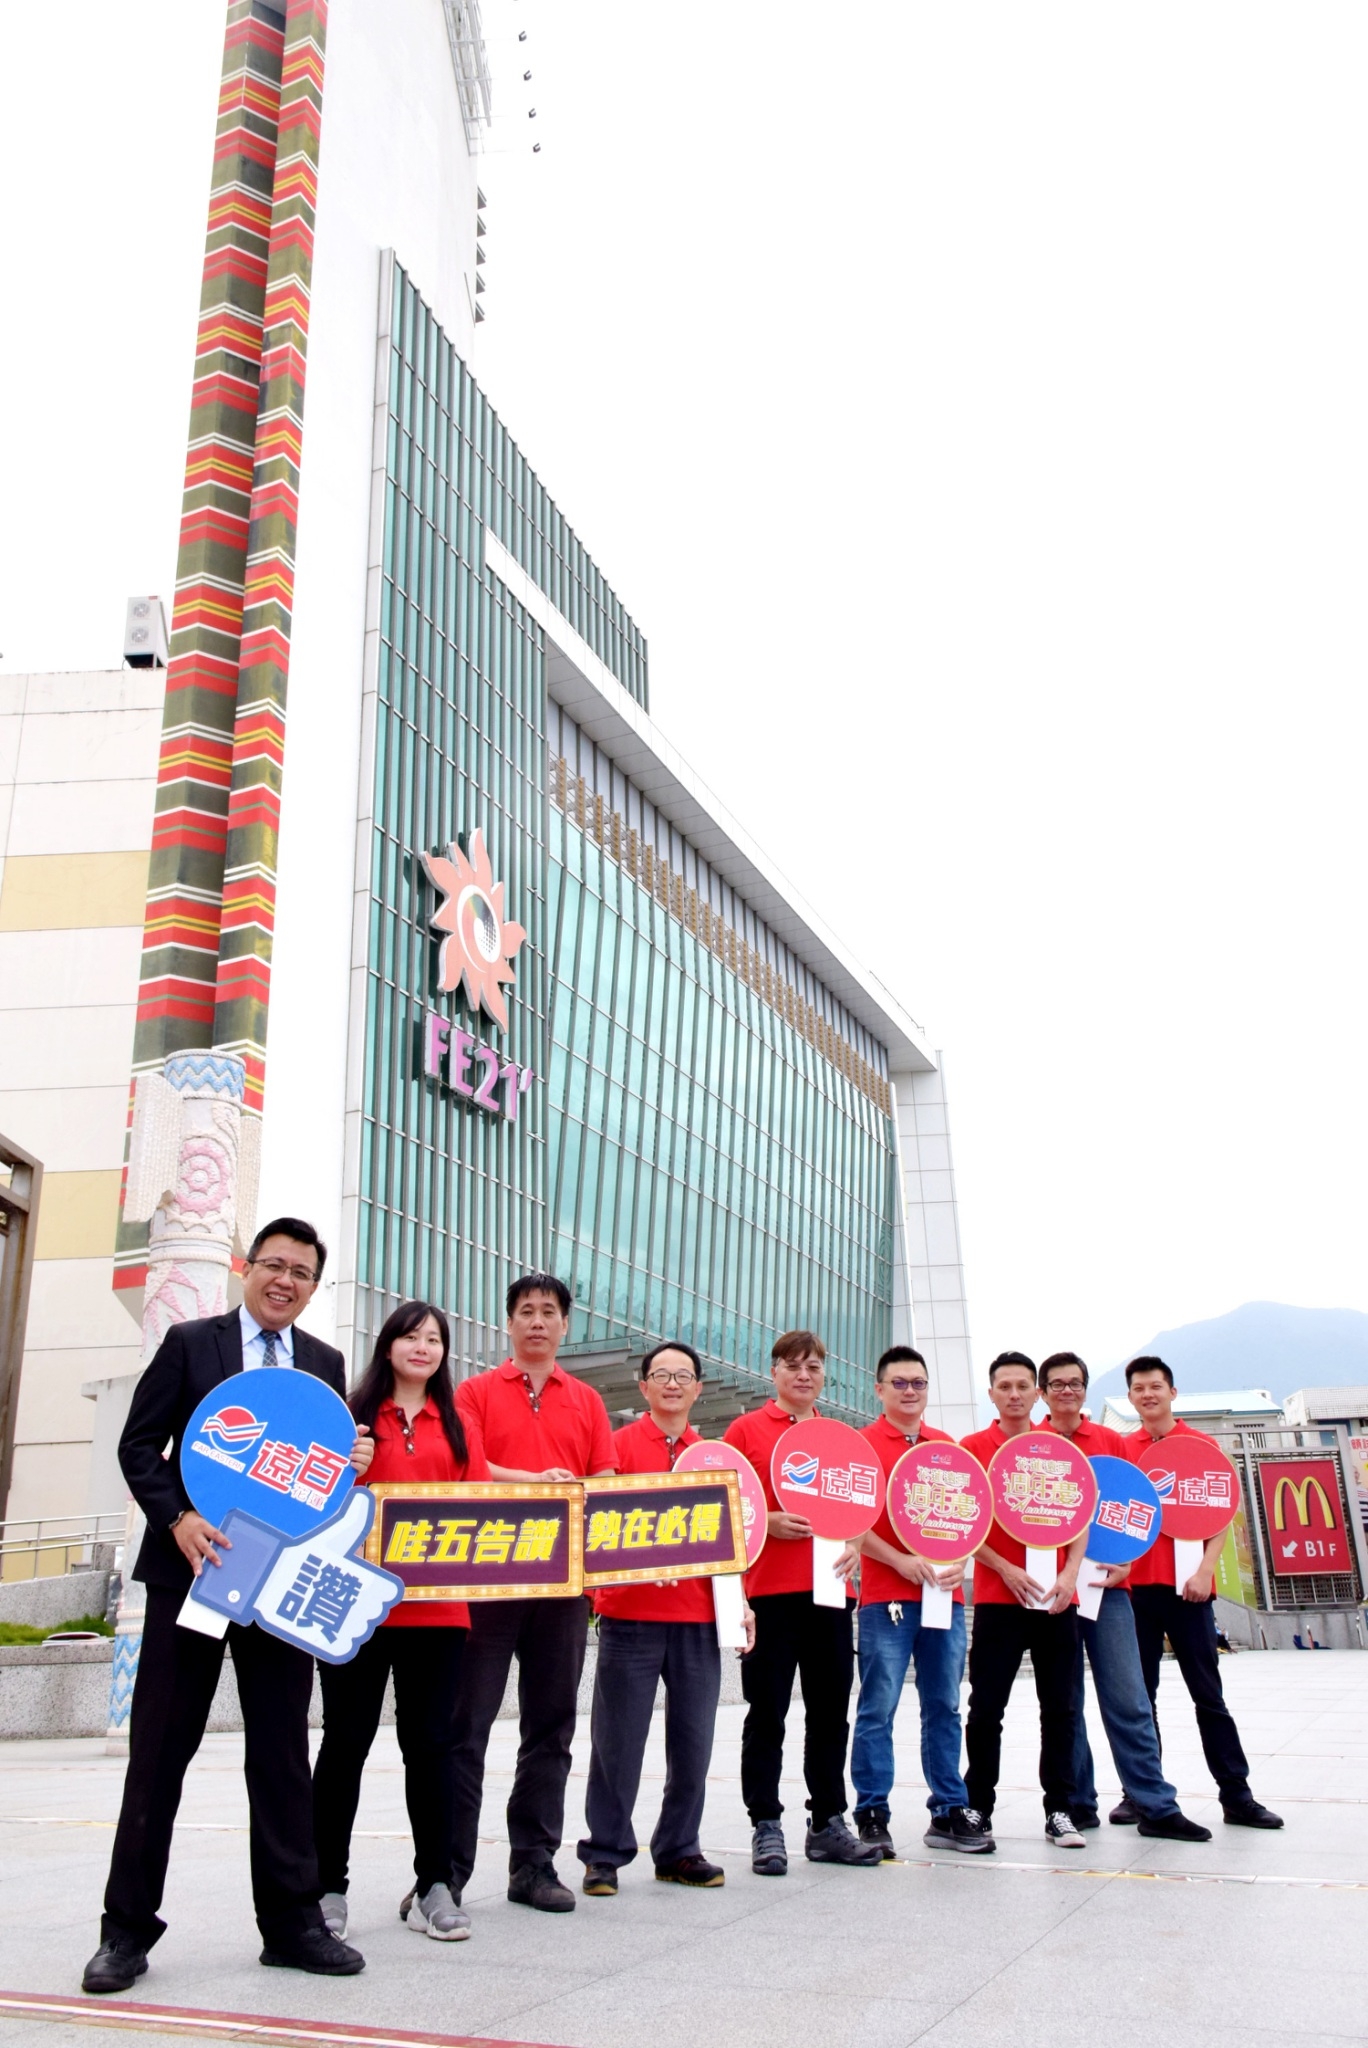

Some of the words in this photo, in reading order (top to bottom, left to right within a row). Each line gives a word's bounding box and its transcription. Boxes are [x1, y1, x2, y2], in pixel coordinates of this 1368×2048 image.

[191, 1440, 210, 1455] FAR
[209, 1449, 246, 1473] EASTERN
[247, 1439, 349, 1497] 遠百
[291, 1482, 328, 1512] 花蓮
[821, 1462, 878, 1502] 遠百
[1003, 1472, 1080, 1507] 週年慶
[1179, 1471, 1231, 1506] 遠百
[904, 1483, 977, 1519] 週年慶
[1096, 1499, 1156, 1533] 遠百
[384, 1517, 562, 1564] 哇五告讚
[586, 1502, 722, 1551] 勢在必得
[276, 1553, 363, 1644] 讚
